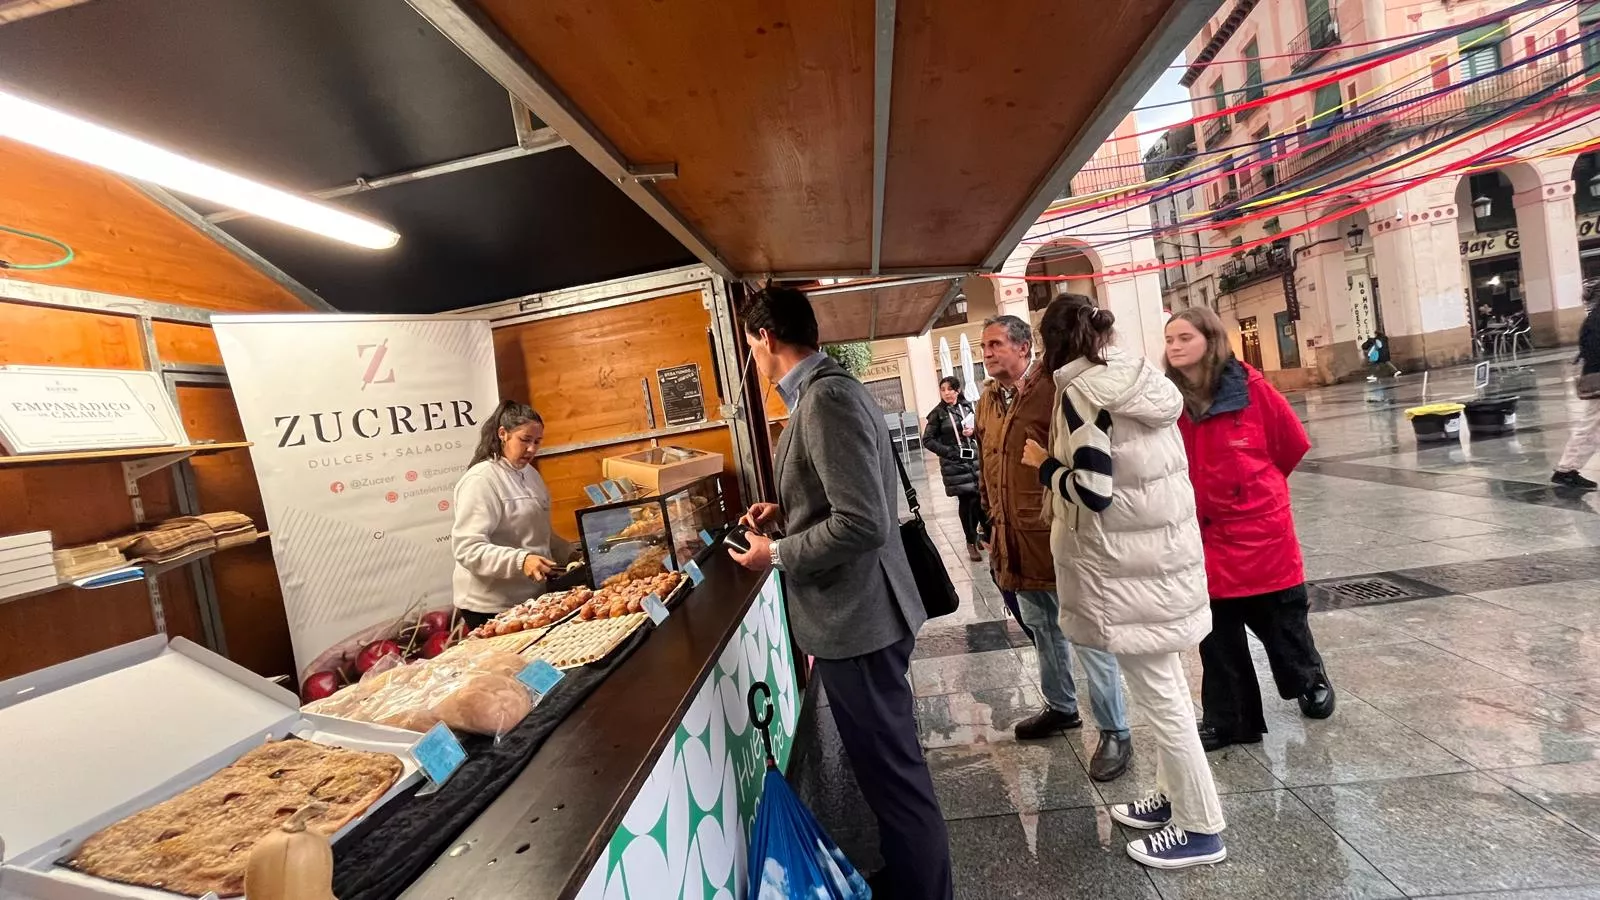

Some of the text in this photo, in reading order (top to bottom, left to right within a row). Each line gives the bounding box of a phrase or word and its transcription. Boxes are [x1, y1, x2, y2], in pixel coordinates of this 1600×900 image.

[11, 401, 131, 412] EMPANADICO
[51, 410, 123, 420] CALABAZA
[274, 399, 478, 448] ZUCRER
[308, 452, 375, 469] DULCES
[396, 440, 463, 458] SALADOS
[350, 475, 396, 490] @Zucrer
